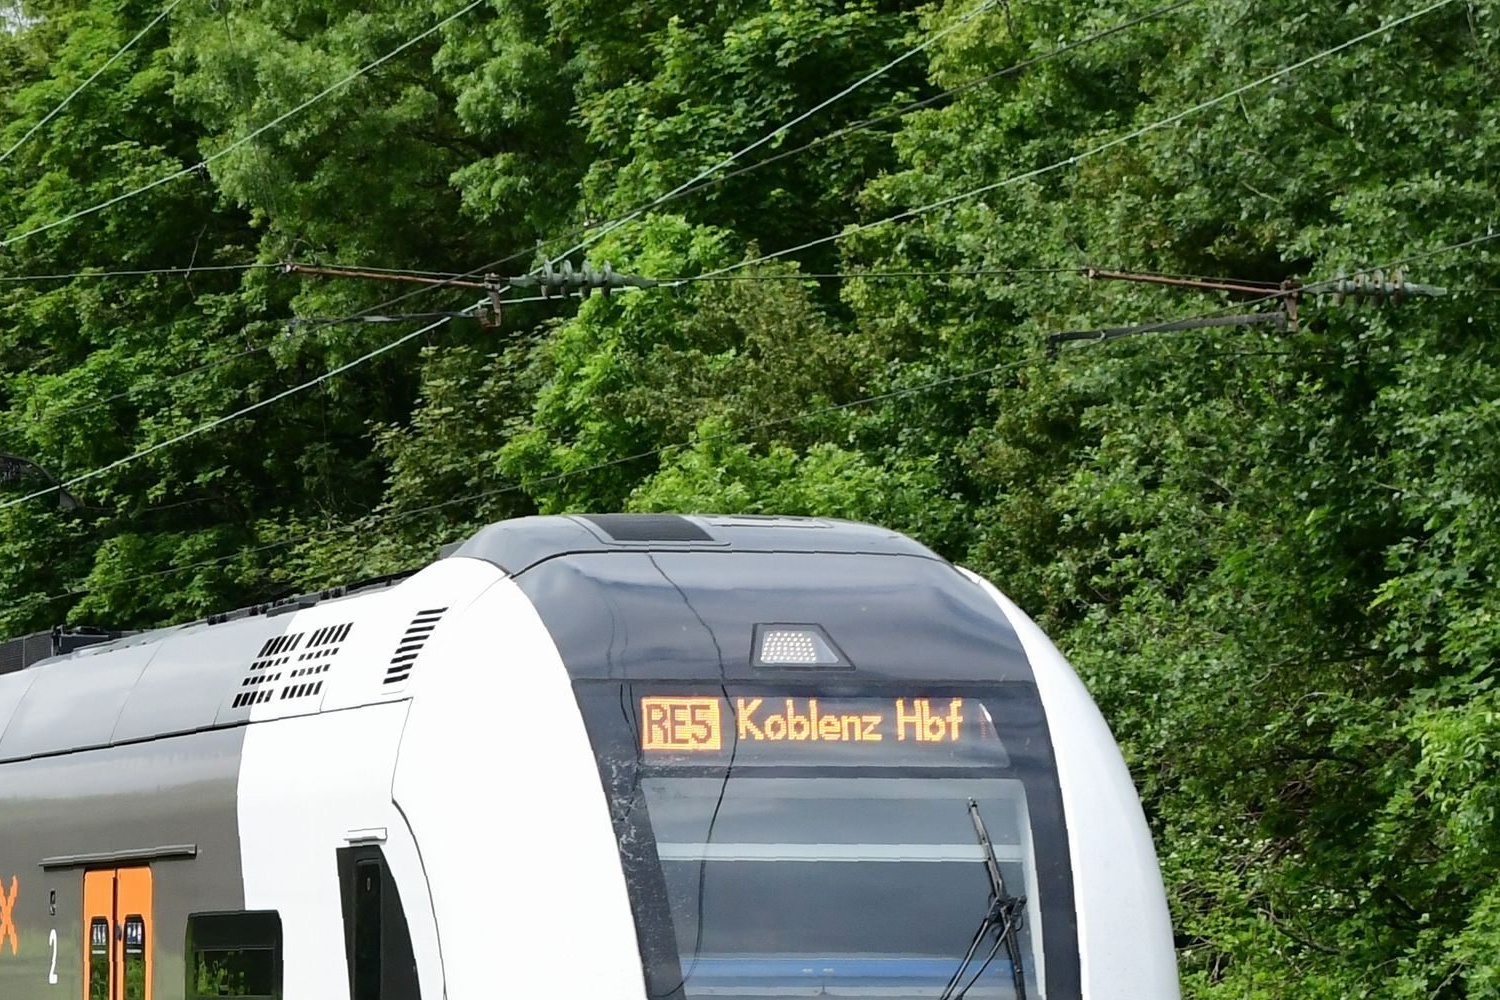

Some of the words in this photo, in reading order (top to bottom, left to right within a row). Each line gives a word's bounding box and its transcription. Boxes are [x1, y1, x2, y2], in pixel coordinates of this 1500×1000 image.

[646, 703, 712, 745] RE5
[737, 698, 884, 742] Koblenz
[897, 698, 964, 742] Hbf
[48, 929, 58, 984] 2
